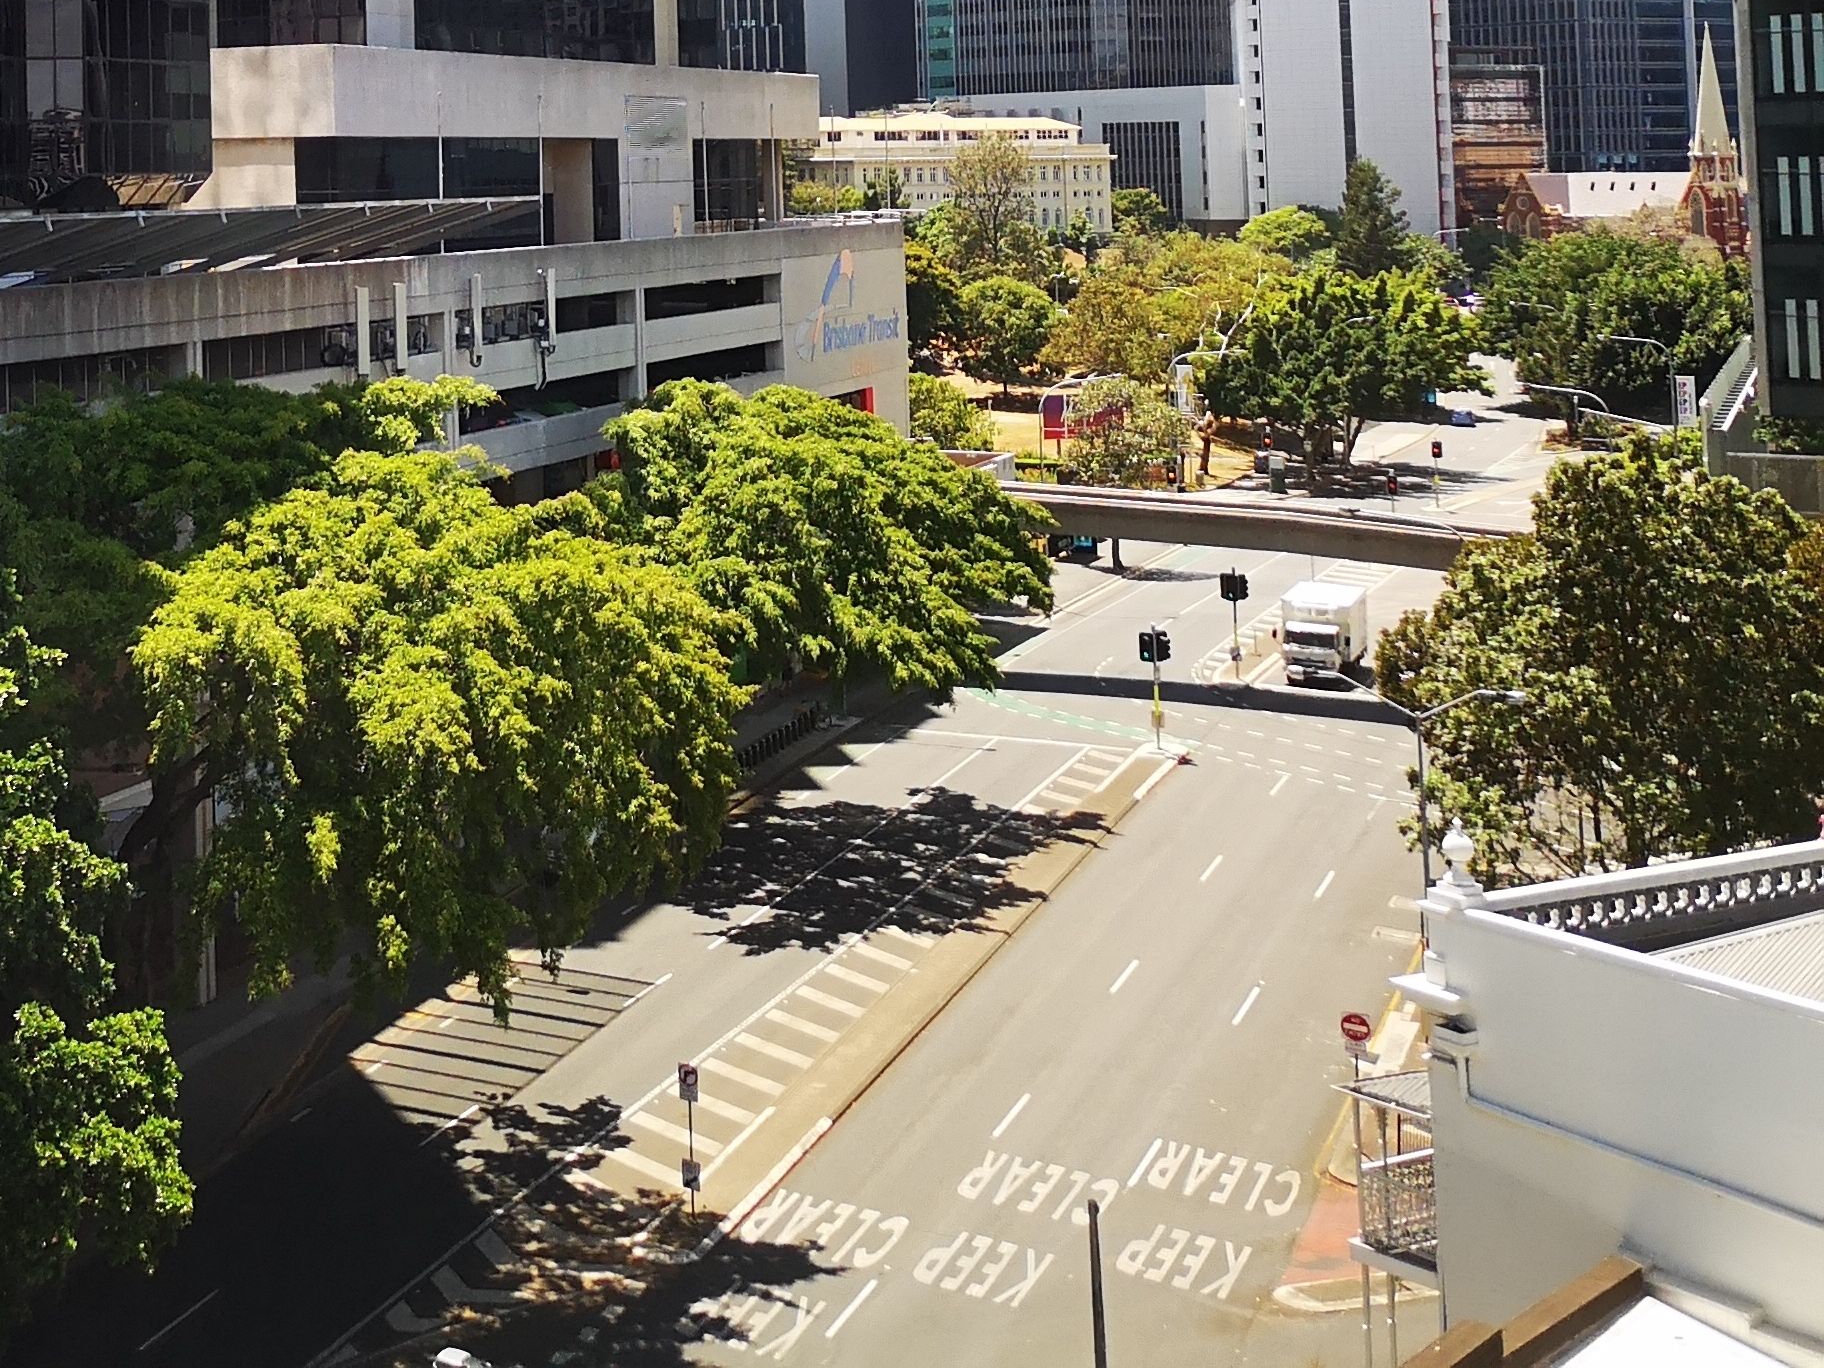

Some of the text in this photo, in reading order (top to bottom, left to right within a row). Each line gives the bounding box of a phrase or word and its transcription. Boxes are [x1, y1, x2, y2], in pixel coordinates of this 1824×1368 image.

[957, 1149, 1121, 1227] CLEAR
[1148, 1140, 1302, 1217] CLEAR
[740, 1188, 910, 1268] CLEAR
[1116, 1224, 1253, 1300] KEEP
[912, 1231, 1055, 1308] KEEP
